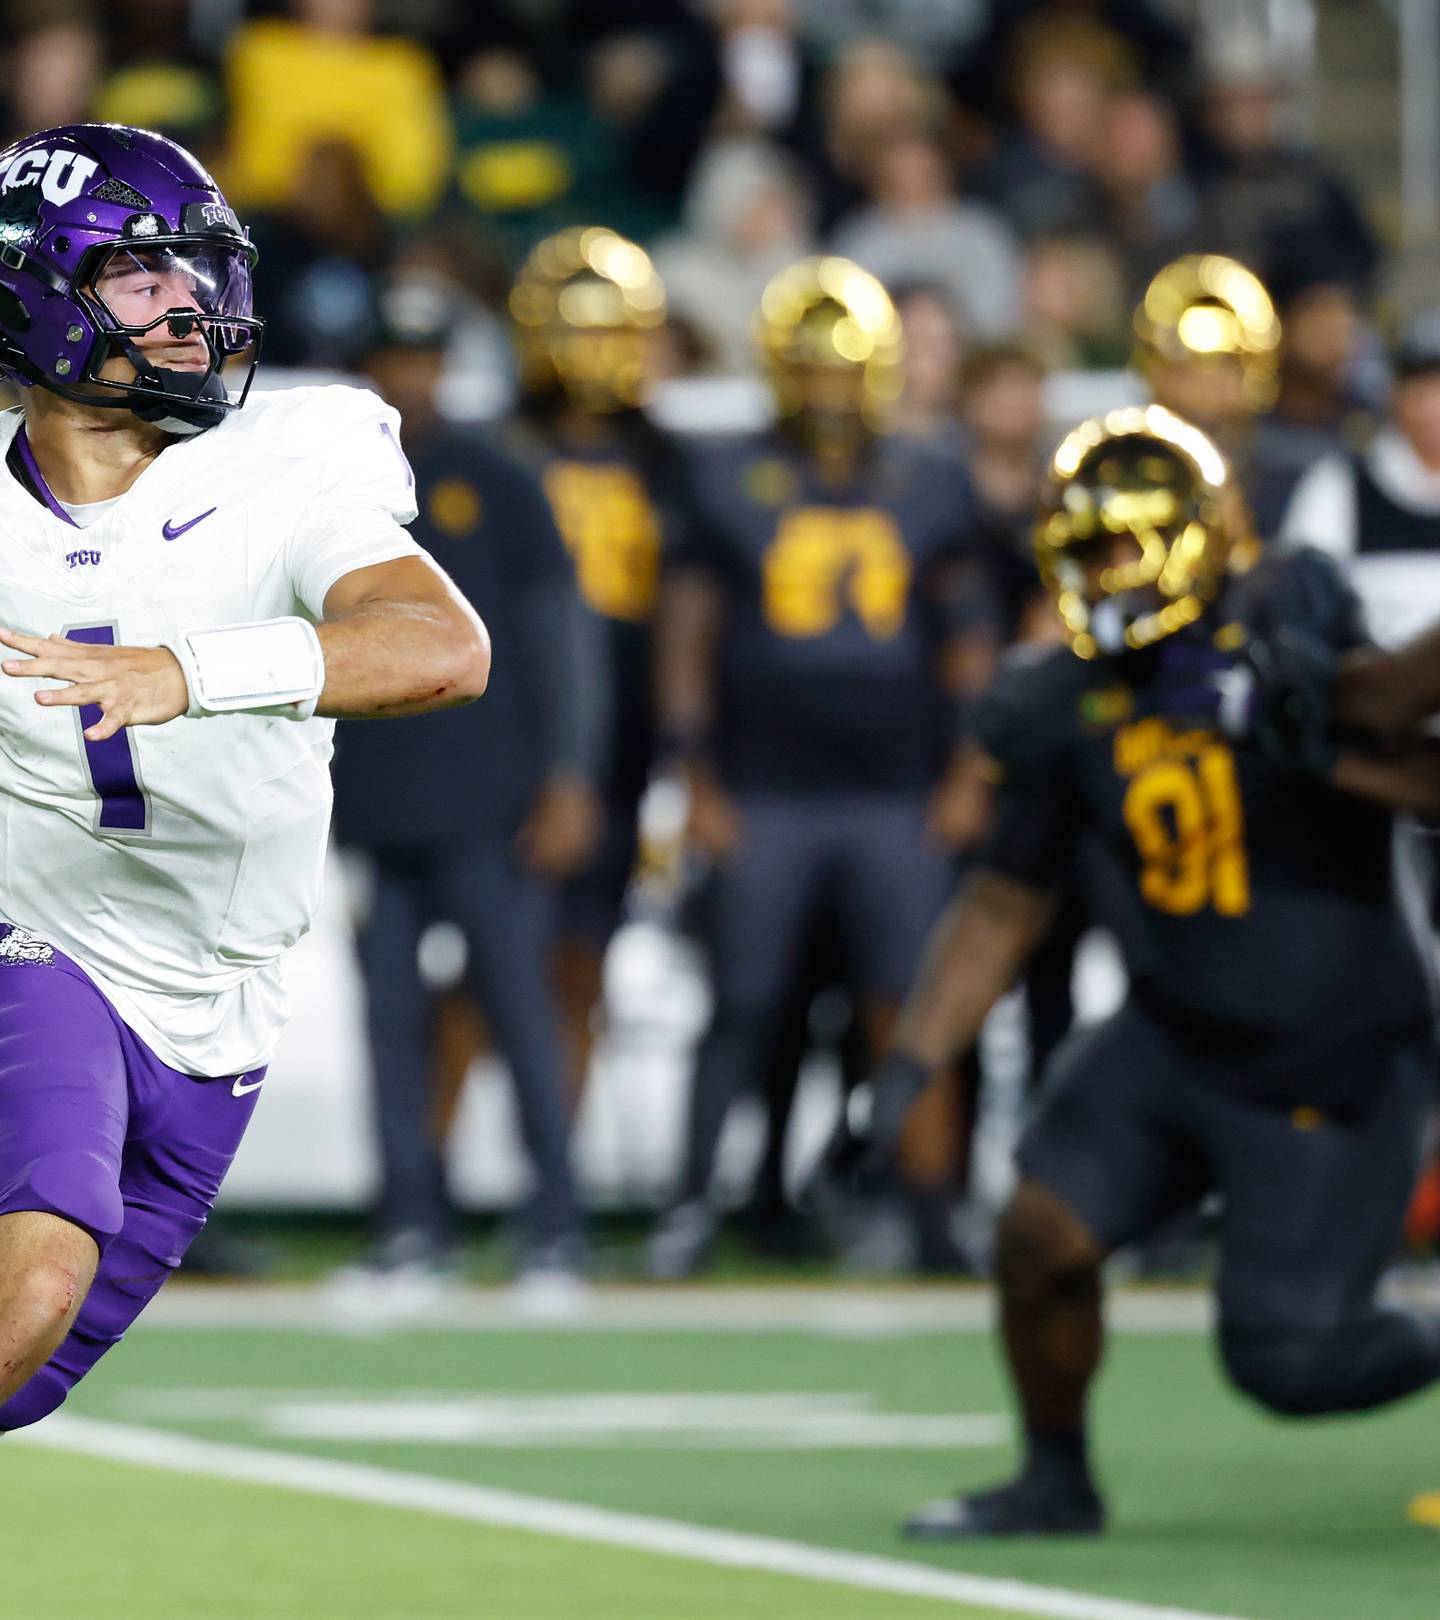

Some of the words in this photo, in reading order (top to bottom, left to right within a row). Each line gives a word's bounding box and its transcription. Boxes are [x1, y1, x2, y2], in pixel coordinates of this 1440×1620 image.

[65, 549, 102, 570] TCU
[62, 618, 153, 837] 1
[1123, 746, 1250, 917] 91
